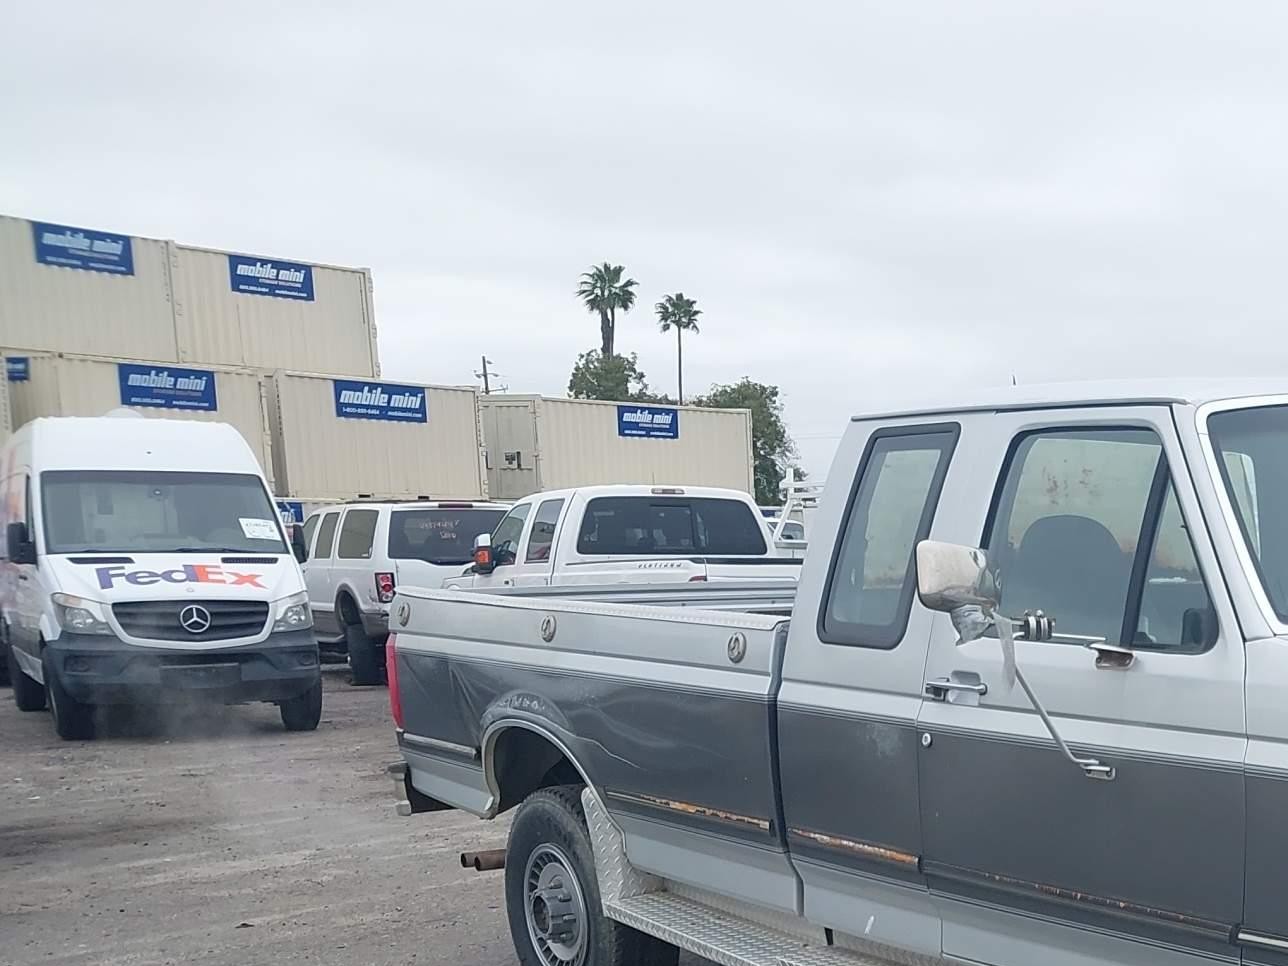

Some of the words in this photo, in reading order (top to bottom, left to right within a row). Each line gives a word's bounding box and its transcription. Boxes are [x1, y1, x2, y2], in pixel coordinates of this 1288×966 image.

[236, 262, 278, 280] mobile
[278, 268, 306, 283] mini
[127, 370, 175, 388] mobile
[175, 375, 208, 391] mini
[340, 386, 389, 407] mobile
[389, 392, 424, 409] mini
[622, 409, 653, 423] mobile
[653, 412, 673, 424] mini
[95, 564, 269, 590] FedEx
